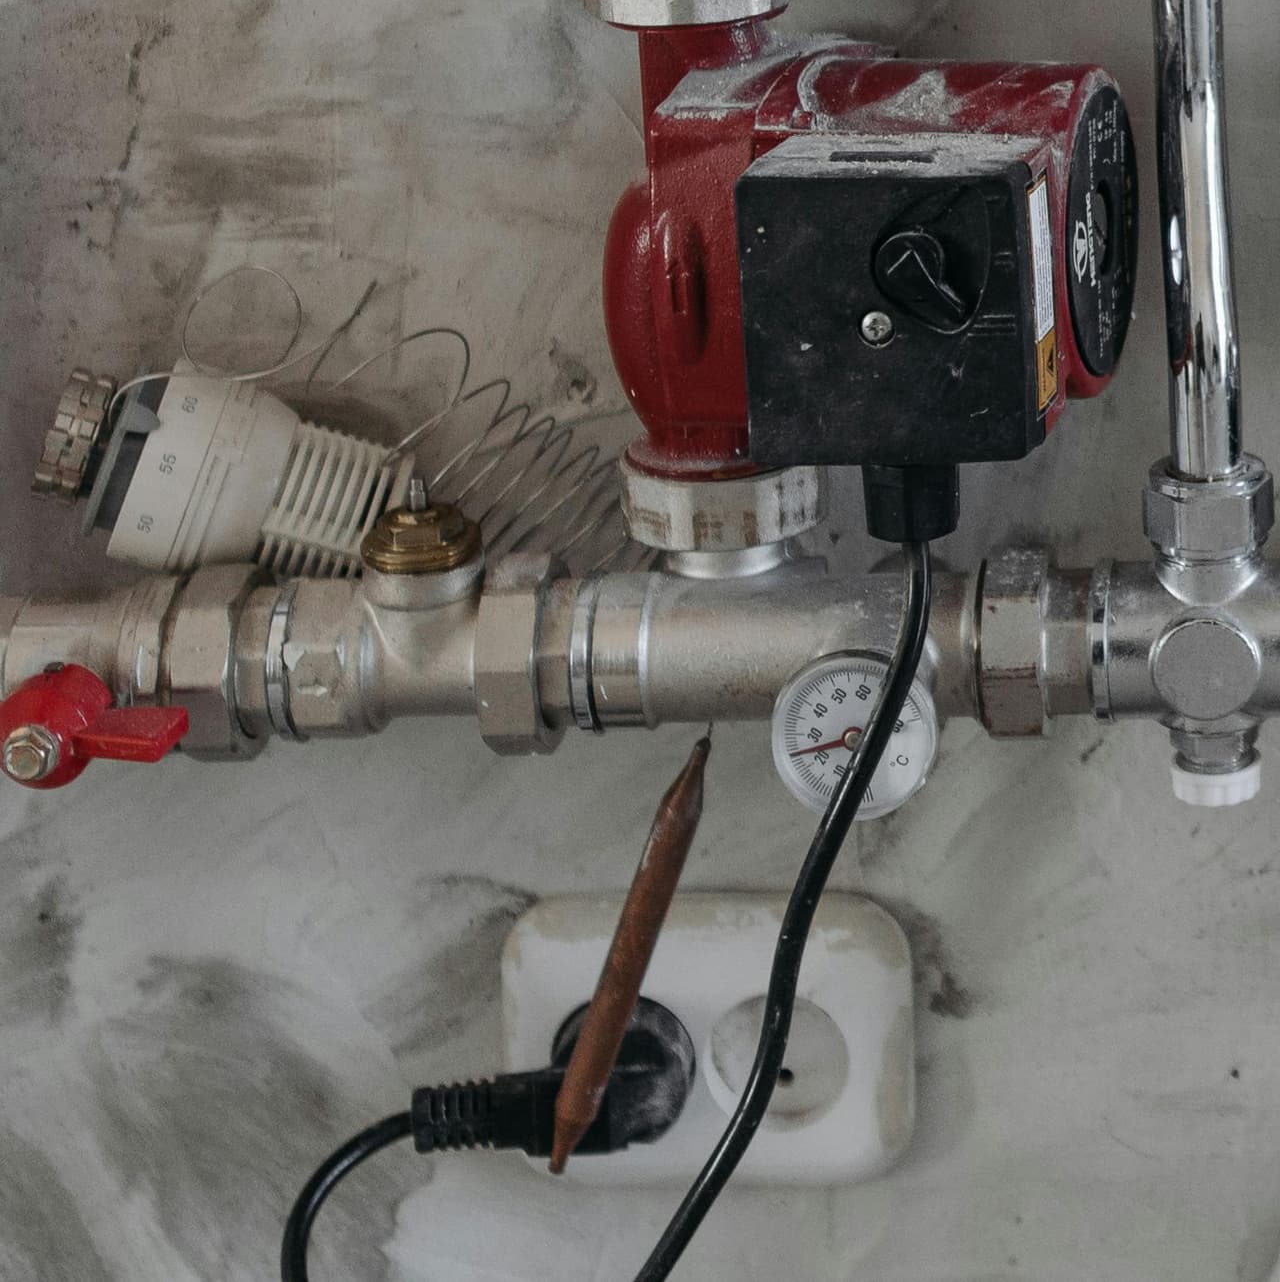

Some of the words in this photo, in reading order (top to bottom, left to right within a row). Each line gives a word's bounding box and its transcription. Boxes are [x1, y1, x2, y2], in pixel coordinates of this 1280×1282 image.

[137, 514, 154, 533] 50
[159, 453, 176, 475] 55
[831, 688, 847, 704] 50
[855, 685, 871, 701] 60
[813, 703, 828, 719] 40
[807, 727, 822, 743] 30
[815, 750, 829, 766] 20
[890, 754, 909, 767] °C
